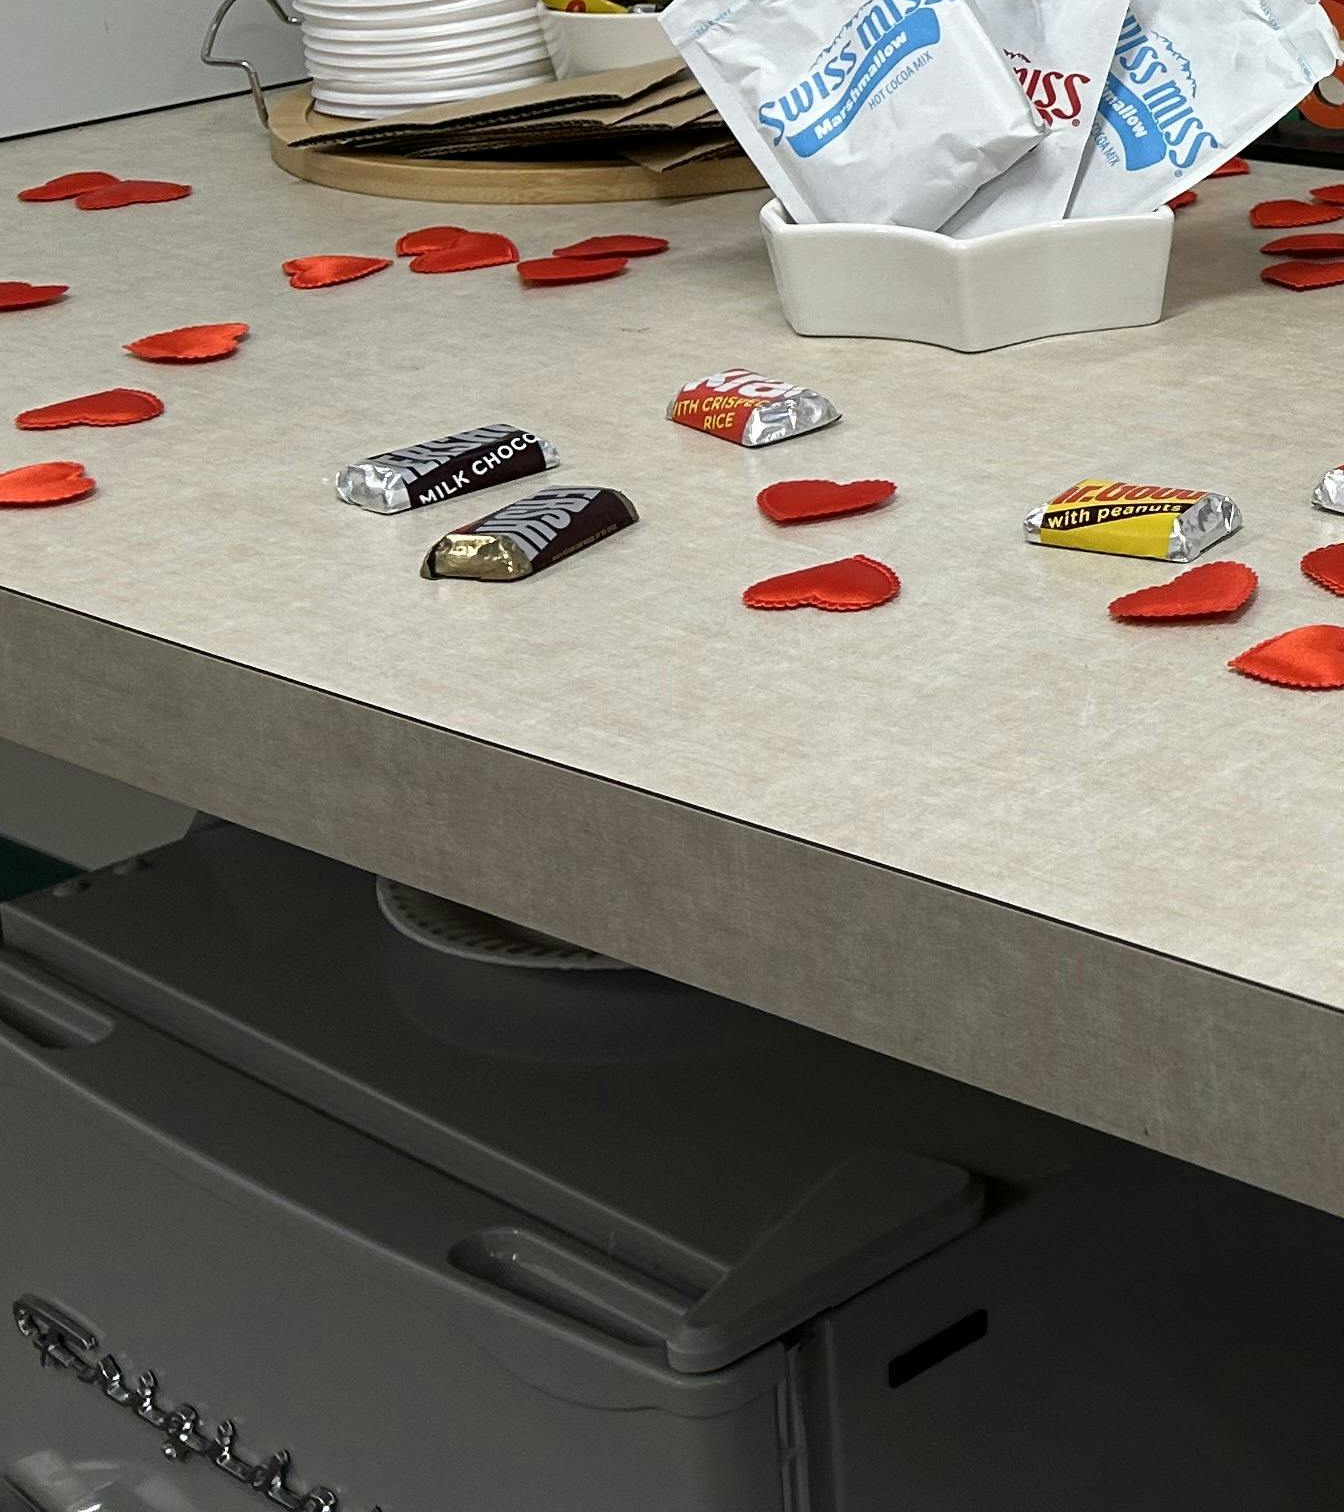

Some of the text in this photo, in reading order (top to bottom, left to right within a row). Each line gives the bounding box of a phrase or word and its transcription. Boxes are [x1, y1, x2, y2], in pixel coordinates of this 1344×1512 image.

[758, 40, 857, 147] SWISS
[813, 31, 908, 140] Marshmallow
[868, 51, 934, 110] HOT COCOA MIX
[1143, 79, 1218, 169] MISS
[703, 412, 735, 430] RICE
[419, 471, 471, 506] MILK
[1048, 504, 1183, 529] with peanuts
